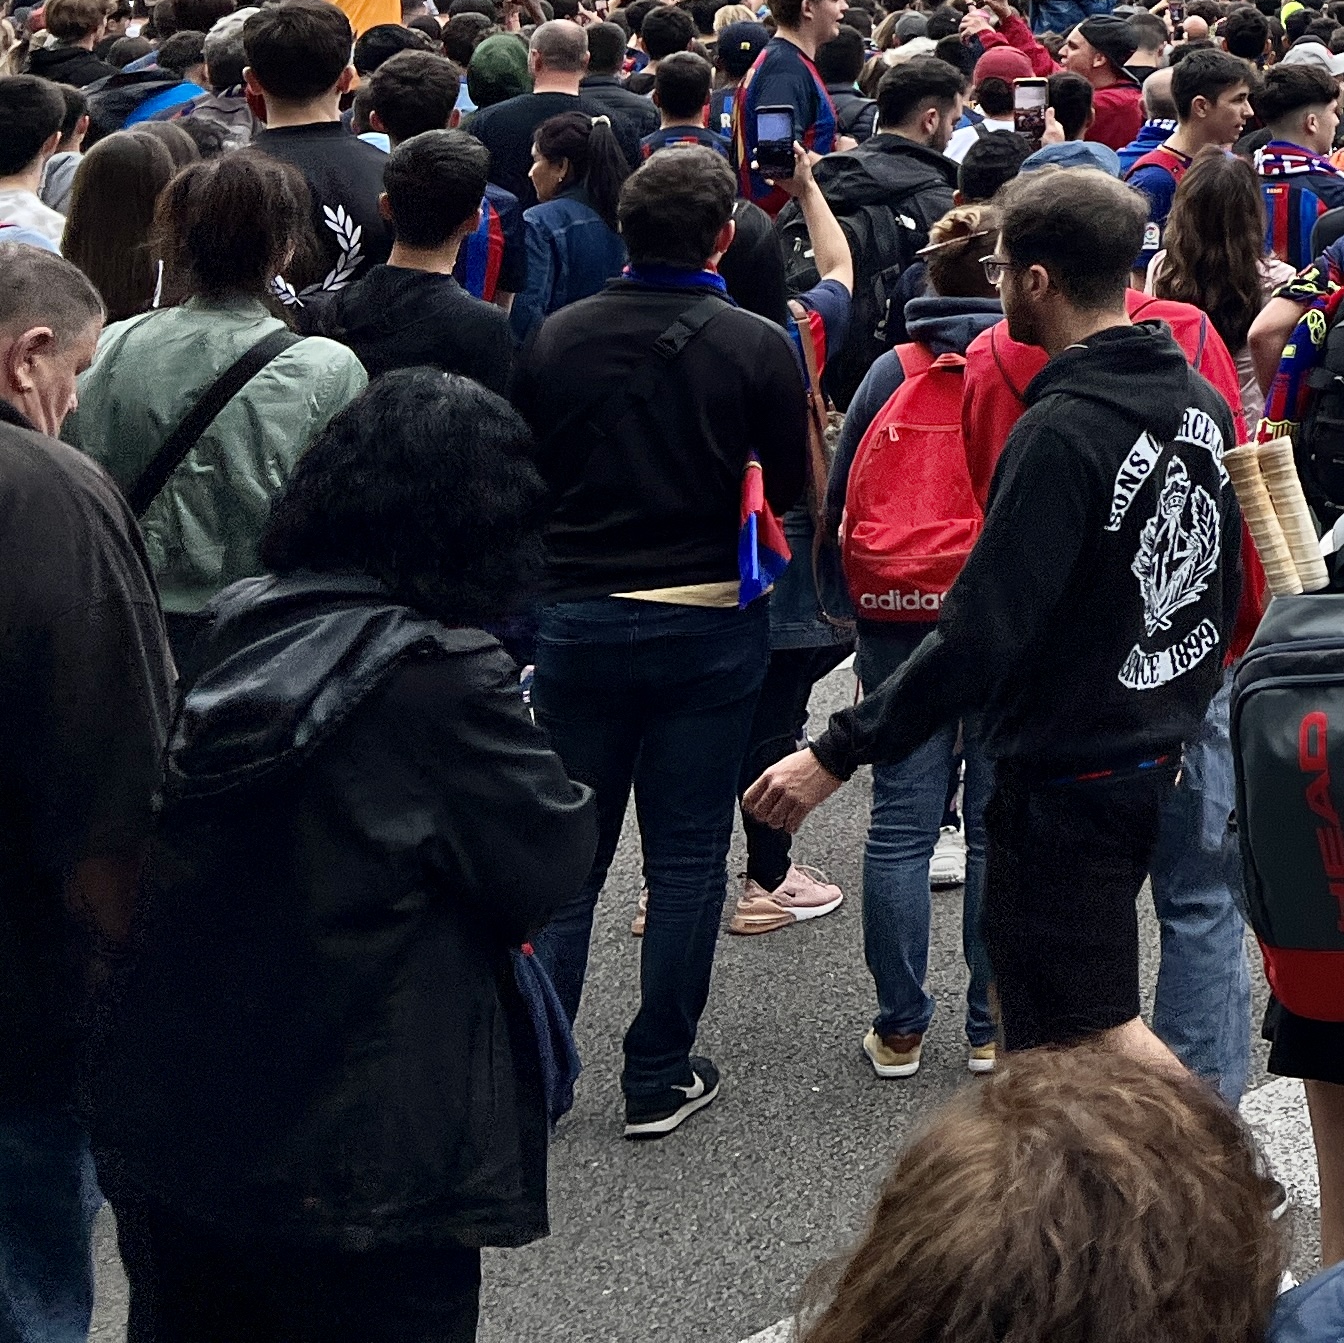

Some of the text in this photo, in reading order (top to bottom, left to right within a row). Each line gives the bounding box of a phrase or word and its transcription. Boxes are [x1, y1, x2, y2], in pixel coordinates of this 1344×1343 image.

[1105, 450, 1150, 529] SONS
[860, 589, 947, 611] adida
[1167, 622, 1216, 675] 1899
